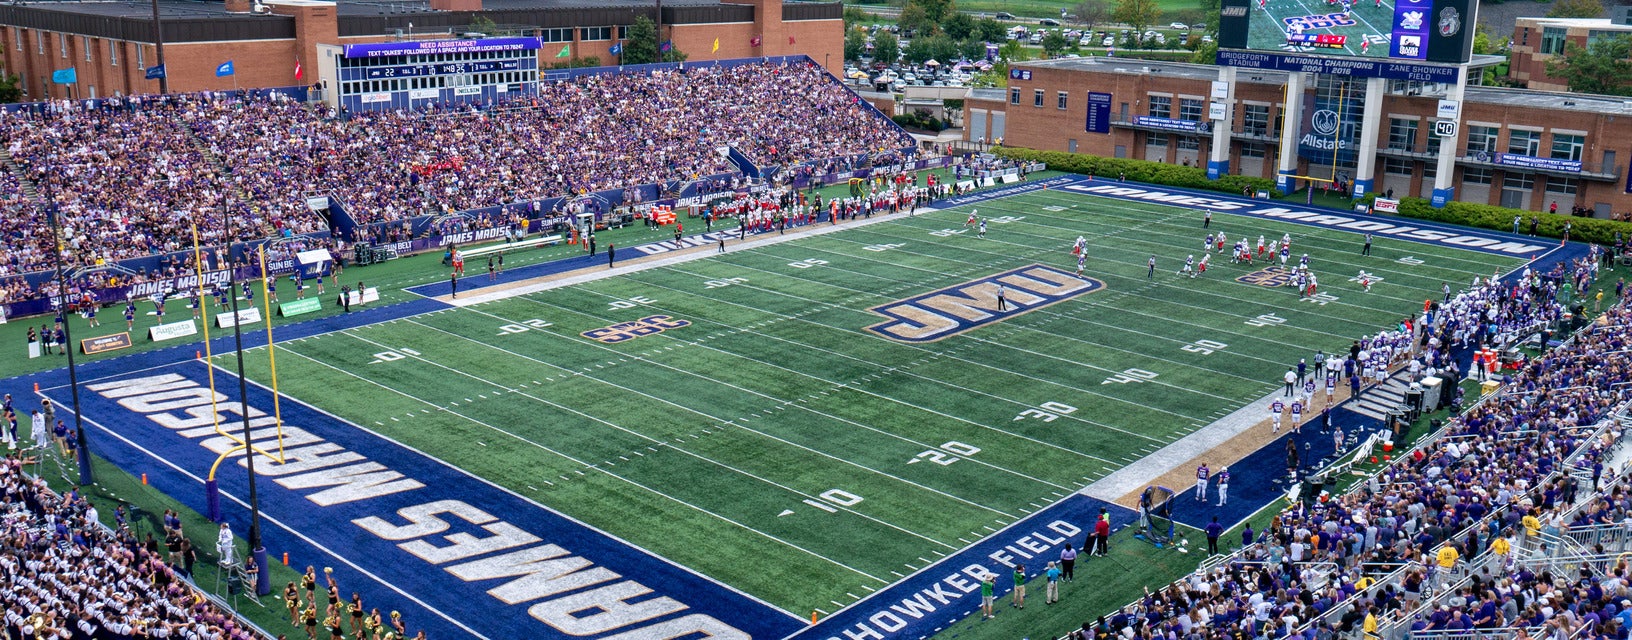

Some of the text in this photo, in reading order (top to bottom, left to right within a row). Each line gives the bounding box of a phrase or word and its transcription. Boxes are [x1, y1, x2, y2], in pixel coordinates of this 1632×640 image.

[1222, 6, 1248, 16] JMU
[437, 40, 477, 48] ASSISTANCE?
[1221, 52, 1269, 61] BRIDGEFORTH
[1228, 59, 1260, 67] STADIUM
[1284, 56, 1374, 69] NATIONAL CHAMPIONS
[385, 68, 395, 76] 22
[1301, 65, 1351, 75] 2004 2016
[1408, 72, 1431, 80] FIELD
[1412, 65, 1453, 75] SHOWKER
[1438, 123, 1453, 134] 40
[1300, 133, 1346, 150] Allstate
[675, 195, 700, 208] JAMES
[1064, 184, 1256, 210] JAMES
[439, 226, 512, 246] JAMES MADISO
[1247, 207, 1547, 254] MADISON
[398, 240, 412, 249] BELT
[268, 262, 282, 271] SUN
[128, 279, 174, 296] JAMES
[609, 296, 658, 309] 30
[868, 265, 1100, 341] JMU
[499, 318, 553, 334] 20
[373, 347, 421, 362] 10
[1180, 339, 1228, 356] 50
[1105, 367, 1159, 384] 40
[1018, 401, 1078, 423] 30
[85, 372, 426, 506] MADISON
[918, 441, 982, 466] 20
[802, 488, 864, 513] 10
[988, 519, 1082, 569] FIELD
